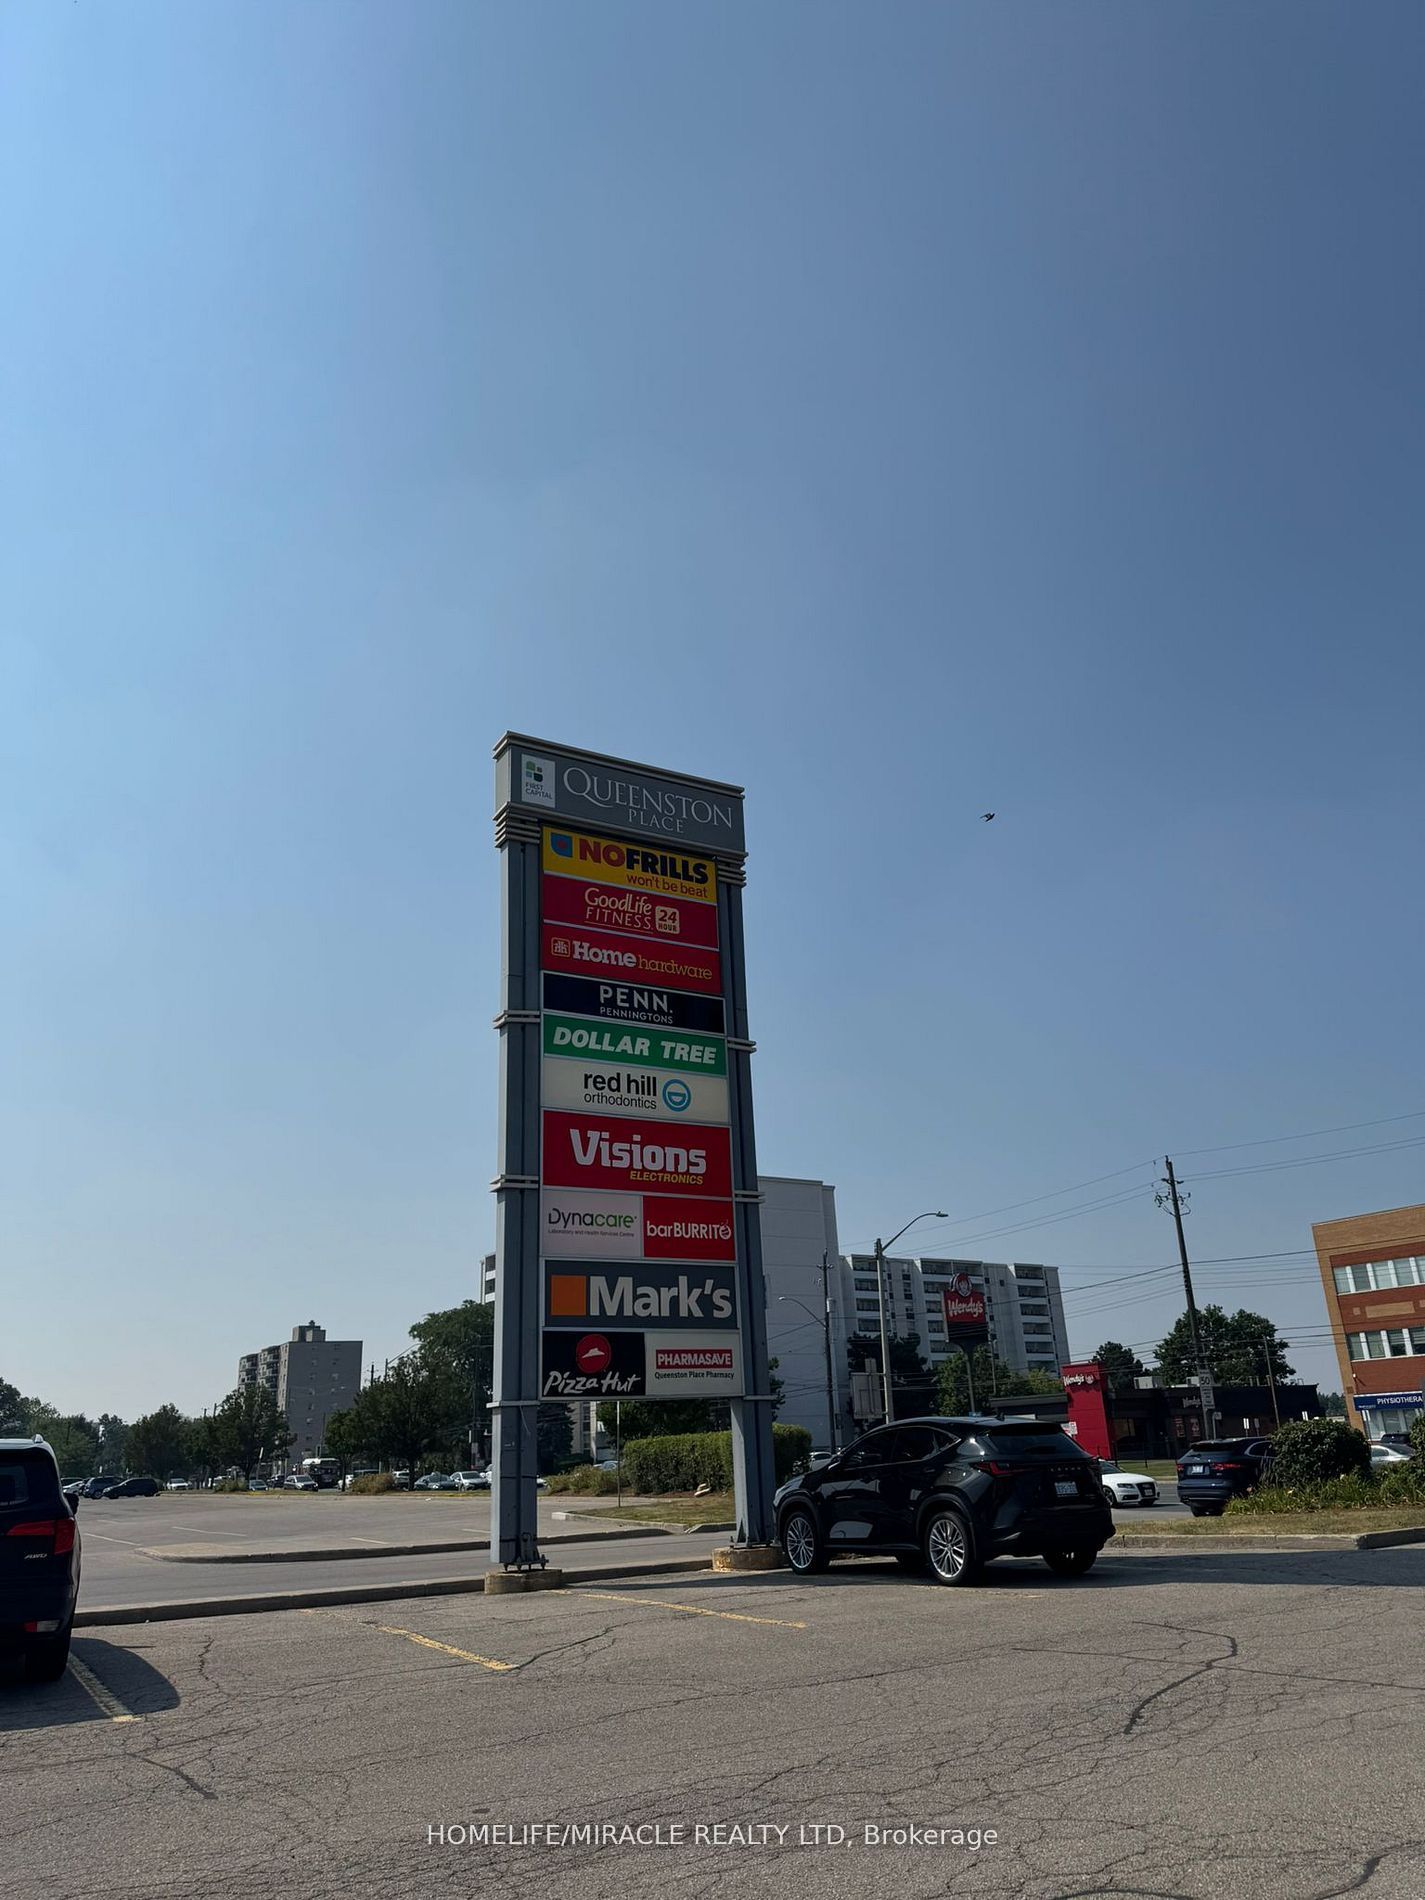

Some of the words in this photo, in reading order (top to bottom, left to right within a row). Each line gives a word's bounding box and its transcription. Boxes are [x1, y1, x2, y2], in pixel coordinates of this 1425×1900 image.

[563, 767, 733, 829] QUEENSTON
[628, 808, 684, 833] PLACE
[626, 873, 661, 889] won't
[662, 877, 678, 893] be
[680, 881, 708, 898] beat
[585, 906, 653, 930] FITNESS
[657, 922, 678, 932] HOUR
[659, 909, 678, 924] 24
[572, 940, 637, 968] Home
[638, 954, 713, 980] hardware
[600, 985, 673, 1014] PENN.
[600, 1006, 673, 1024] PENNINGTONS
[553, 1026, 650, 1056] DOLLAR
[661, 1040, 717, 1065] TREE
[584, 1072, 621, 1093] red
[626, 1073, 657, 1097] hill
[584, 1091, 657, 1110] orthodontics
[569, 1128, 707, 1174] Visions
[629, 1170, 704, 1185] ELECTRONICS
[548, 1207, 634, 1229] Dynacare
[589, 1275, 733, 1318] Mark's
[947, 1297, 984, 1318] Wendy's
[657, 1353, 732, 1366] PHARMASAVE
[543, 1371, 599, 1394] Pizza
[601, 1372, 641, 1393] Hut
[654, 1370, 688, 1379] Queenston
[705, 1371, 735, 1380] Pharmacy
[1199, 1376, 1210, 1385] 50
